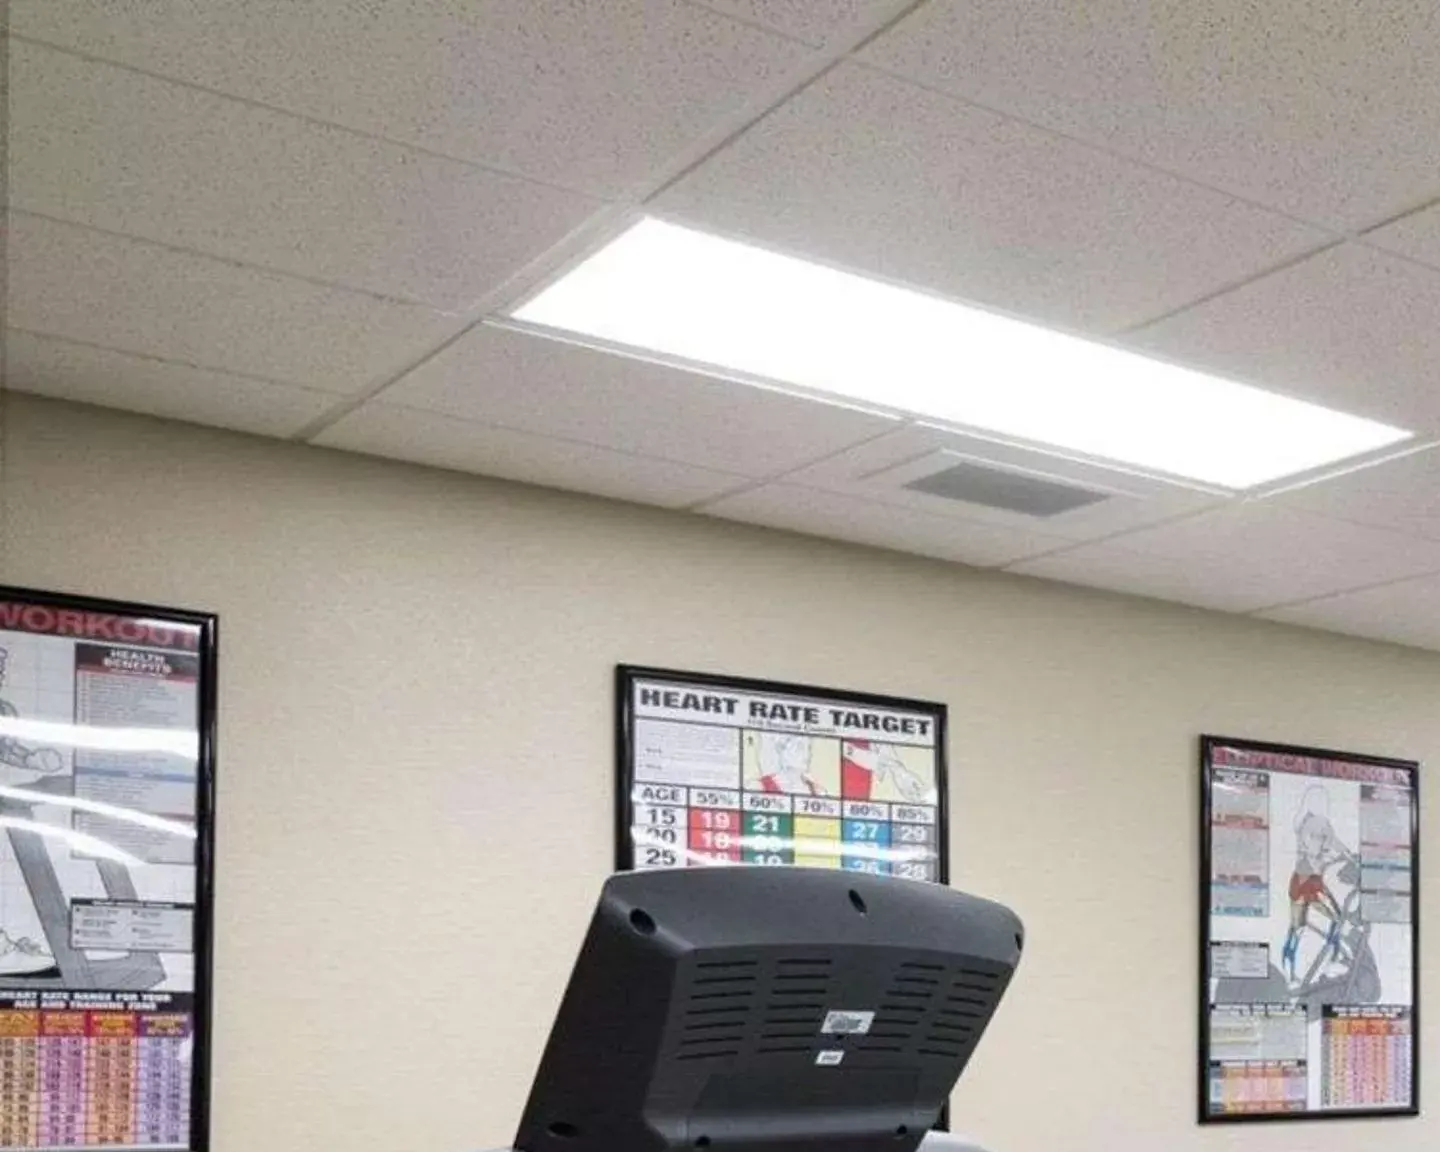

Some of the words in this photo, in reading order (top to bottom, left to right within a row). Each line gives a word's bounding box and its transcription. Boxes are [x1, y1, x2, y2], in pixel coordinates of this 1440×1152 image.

[640, 688, 739, 715] HEART
[748, 701, 820, 725] RATE
[829, 708, 930, 735] TARGET
[641, 786, 680, 801] AGE
[802, 800, 834, 813] 70%
[646, 808, 676, 825] 15
[701, 811, 731, 829] 19
[752, 814, 780, 833] 21
[852, 821, 879, 840] 27
[900, 825, 927, 842] 29
[646, 848, 676, 866] 25
